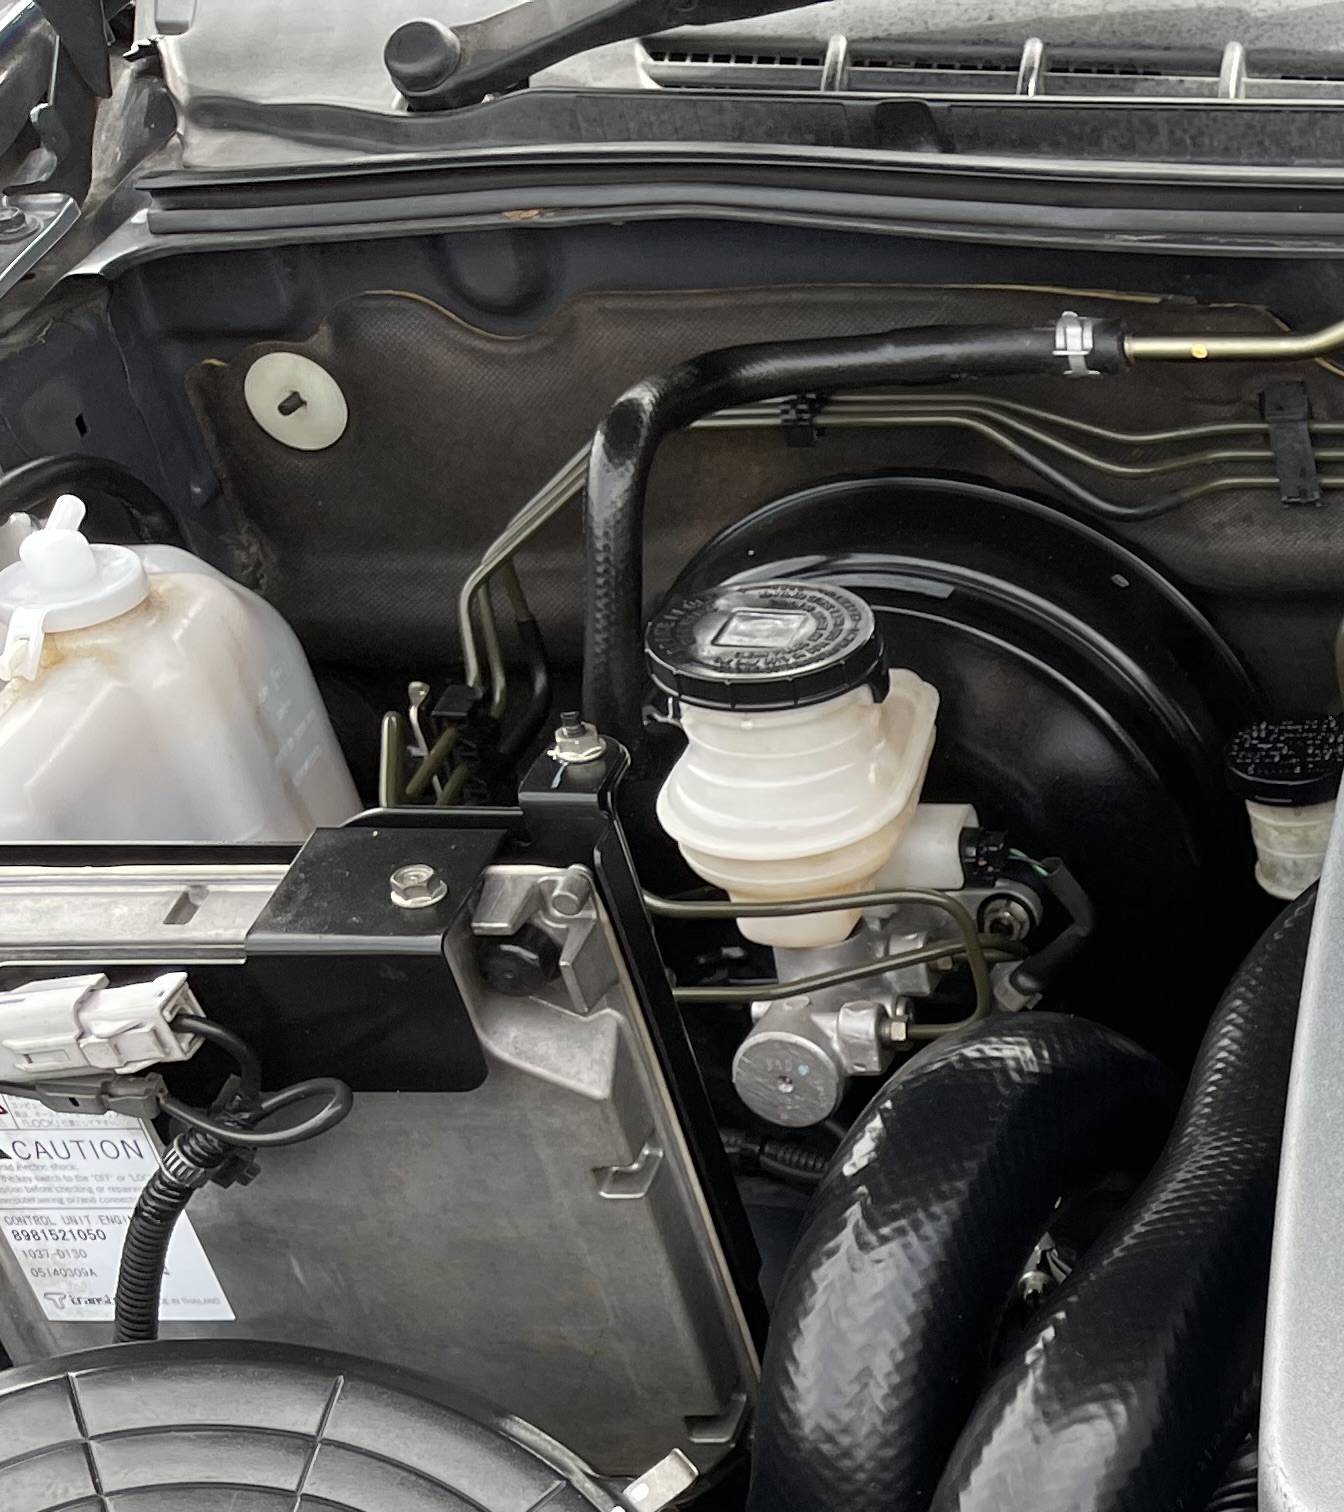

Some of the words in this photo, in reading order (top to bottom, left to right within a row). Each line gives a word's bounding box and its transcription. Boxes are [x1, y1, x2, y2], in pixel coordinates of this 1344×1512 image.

[11, 1139, 145, 1161] CAUTION
[4, 1215, 57, 1226] CONTROL
[62, 1215, 91, 1226] UNIT
[11, 1229, 108, 1242] 8981521050
